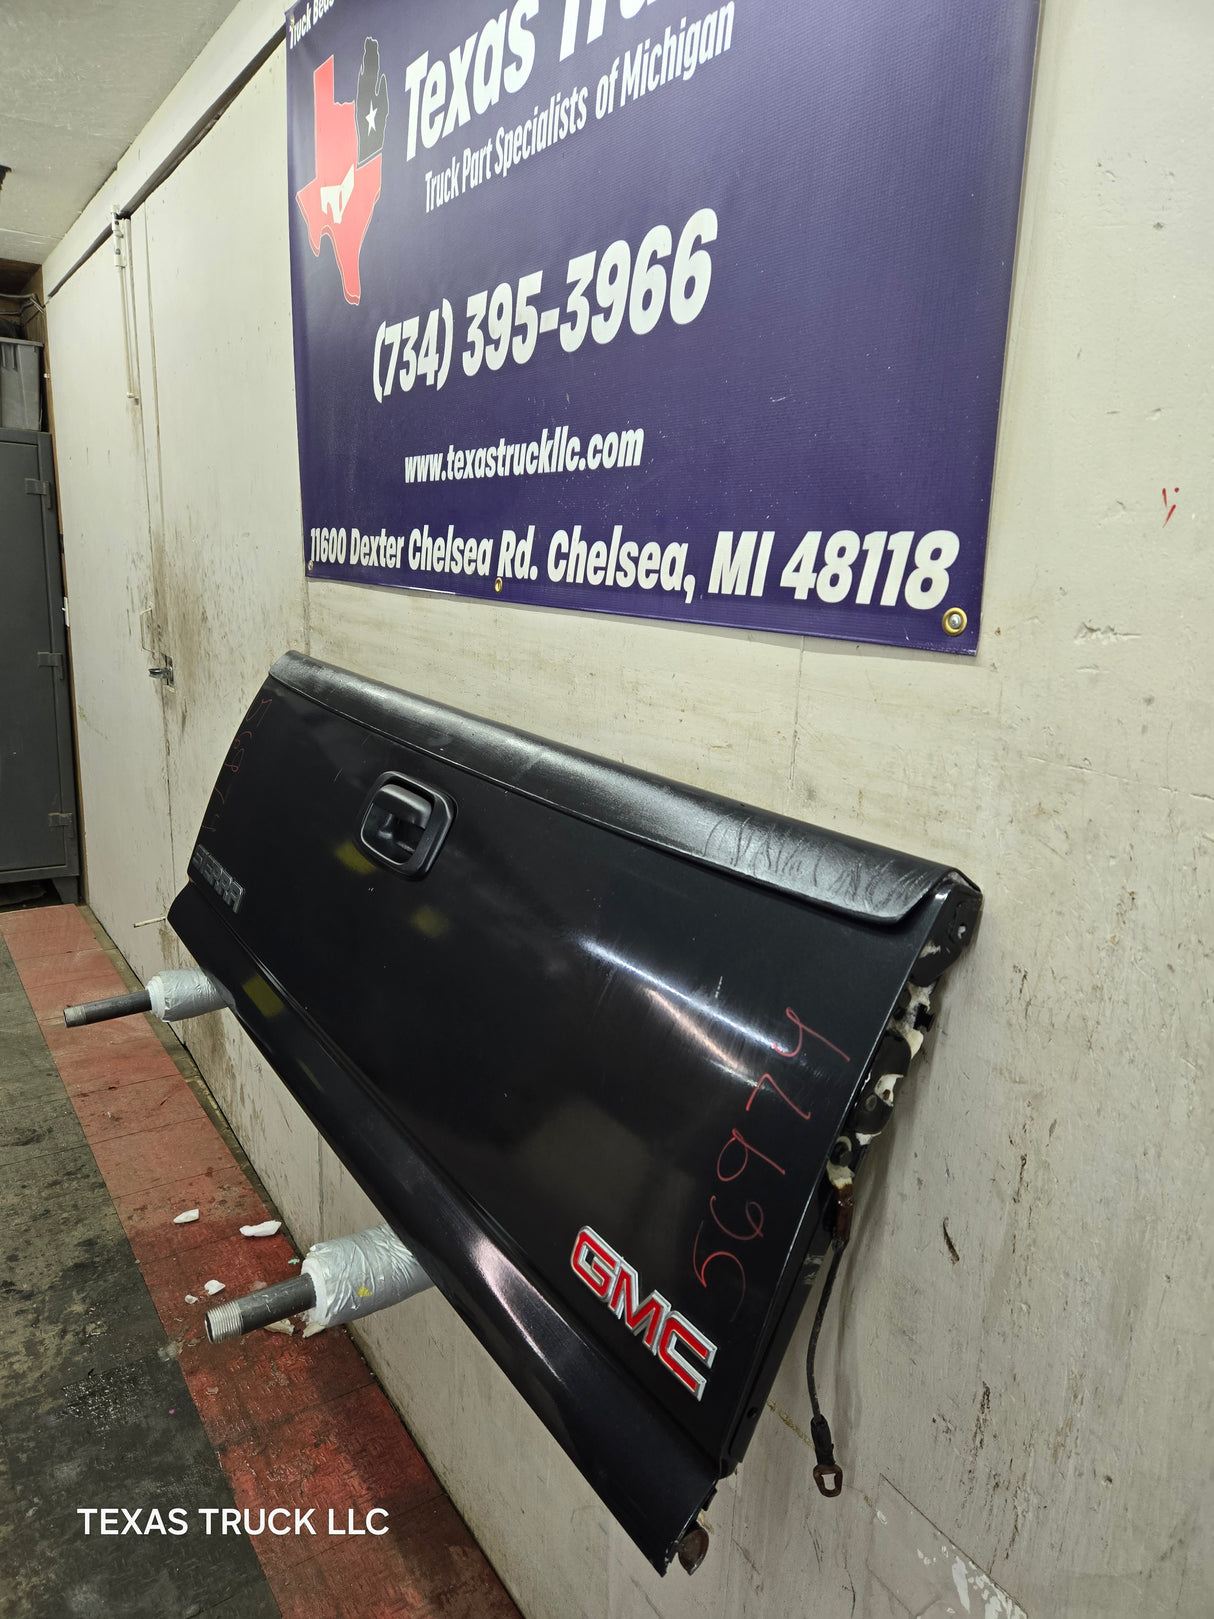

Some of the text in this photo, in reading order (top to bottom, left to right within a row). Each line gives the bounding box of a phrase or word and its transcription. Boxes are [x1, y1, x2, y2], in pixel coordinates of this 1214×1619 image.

[289, 2, 311, 49] Truck
[404, 0, 540, 162] Texas
[425, 156, 461, 213] Truck
[462, 138, 493, 193] Part
[494, 86, 589, 178] Specialists
[596, 56, 620, 120] of
[620, 1, 735, 107] Michigan
[373, 208, 718, 404] (734) 395-3966
[404, 426, 645, 483] www.texastruckllc.com
[310, 525, 960, 610] 11600 Dexter Chelsea Rd. Chelsea, MI 48118
[693, 1007, 850, 1322] 56974
[571, 1225, 718, 1401] GMC
